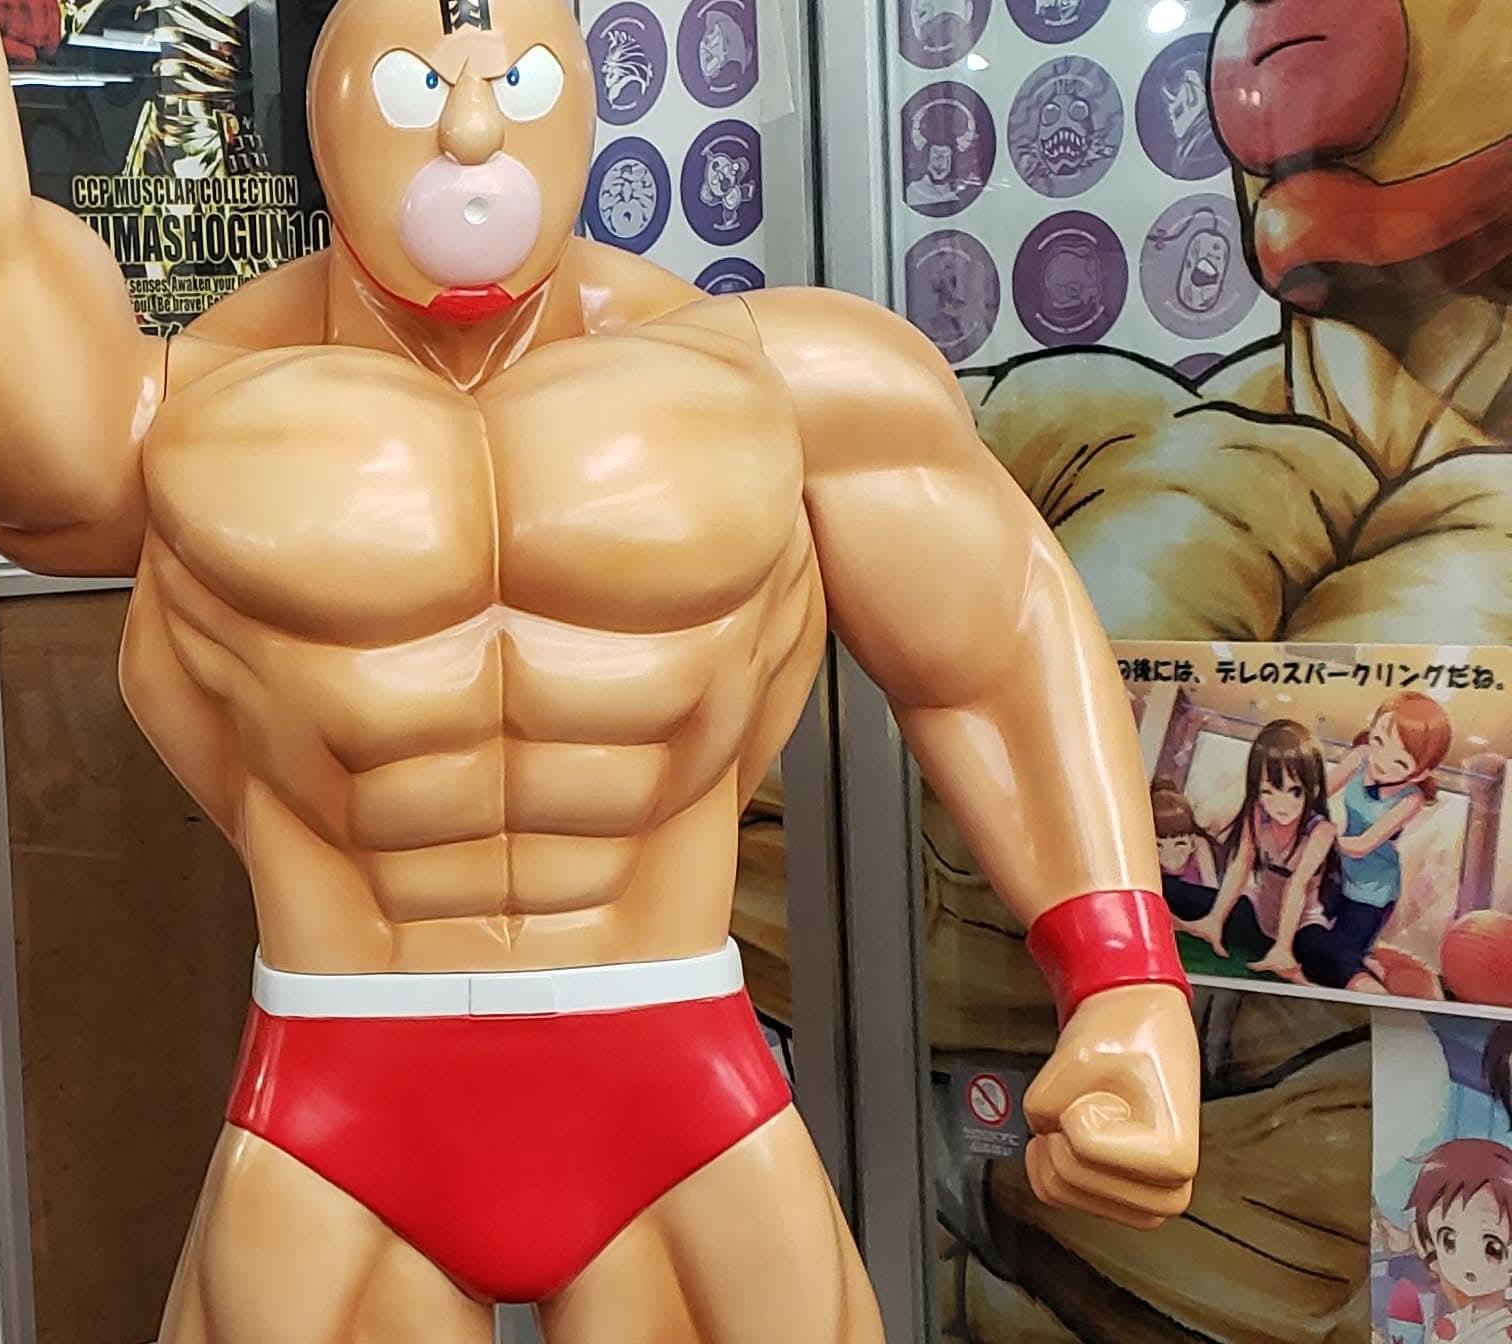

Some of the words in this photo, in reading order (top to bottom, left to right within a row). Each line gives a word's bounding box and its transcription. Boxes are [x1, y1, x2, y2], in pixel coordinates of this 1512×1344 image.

[72, 175, 110, 207] CCP
[112, 175, 196, 206] MUSCLAR
[198, 175, 299, 206] COLLECTION
[171, 274, 212, 293] Awaken
[213, 275, 237, 296] your
